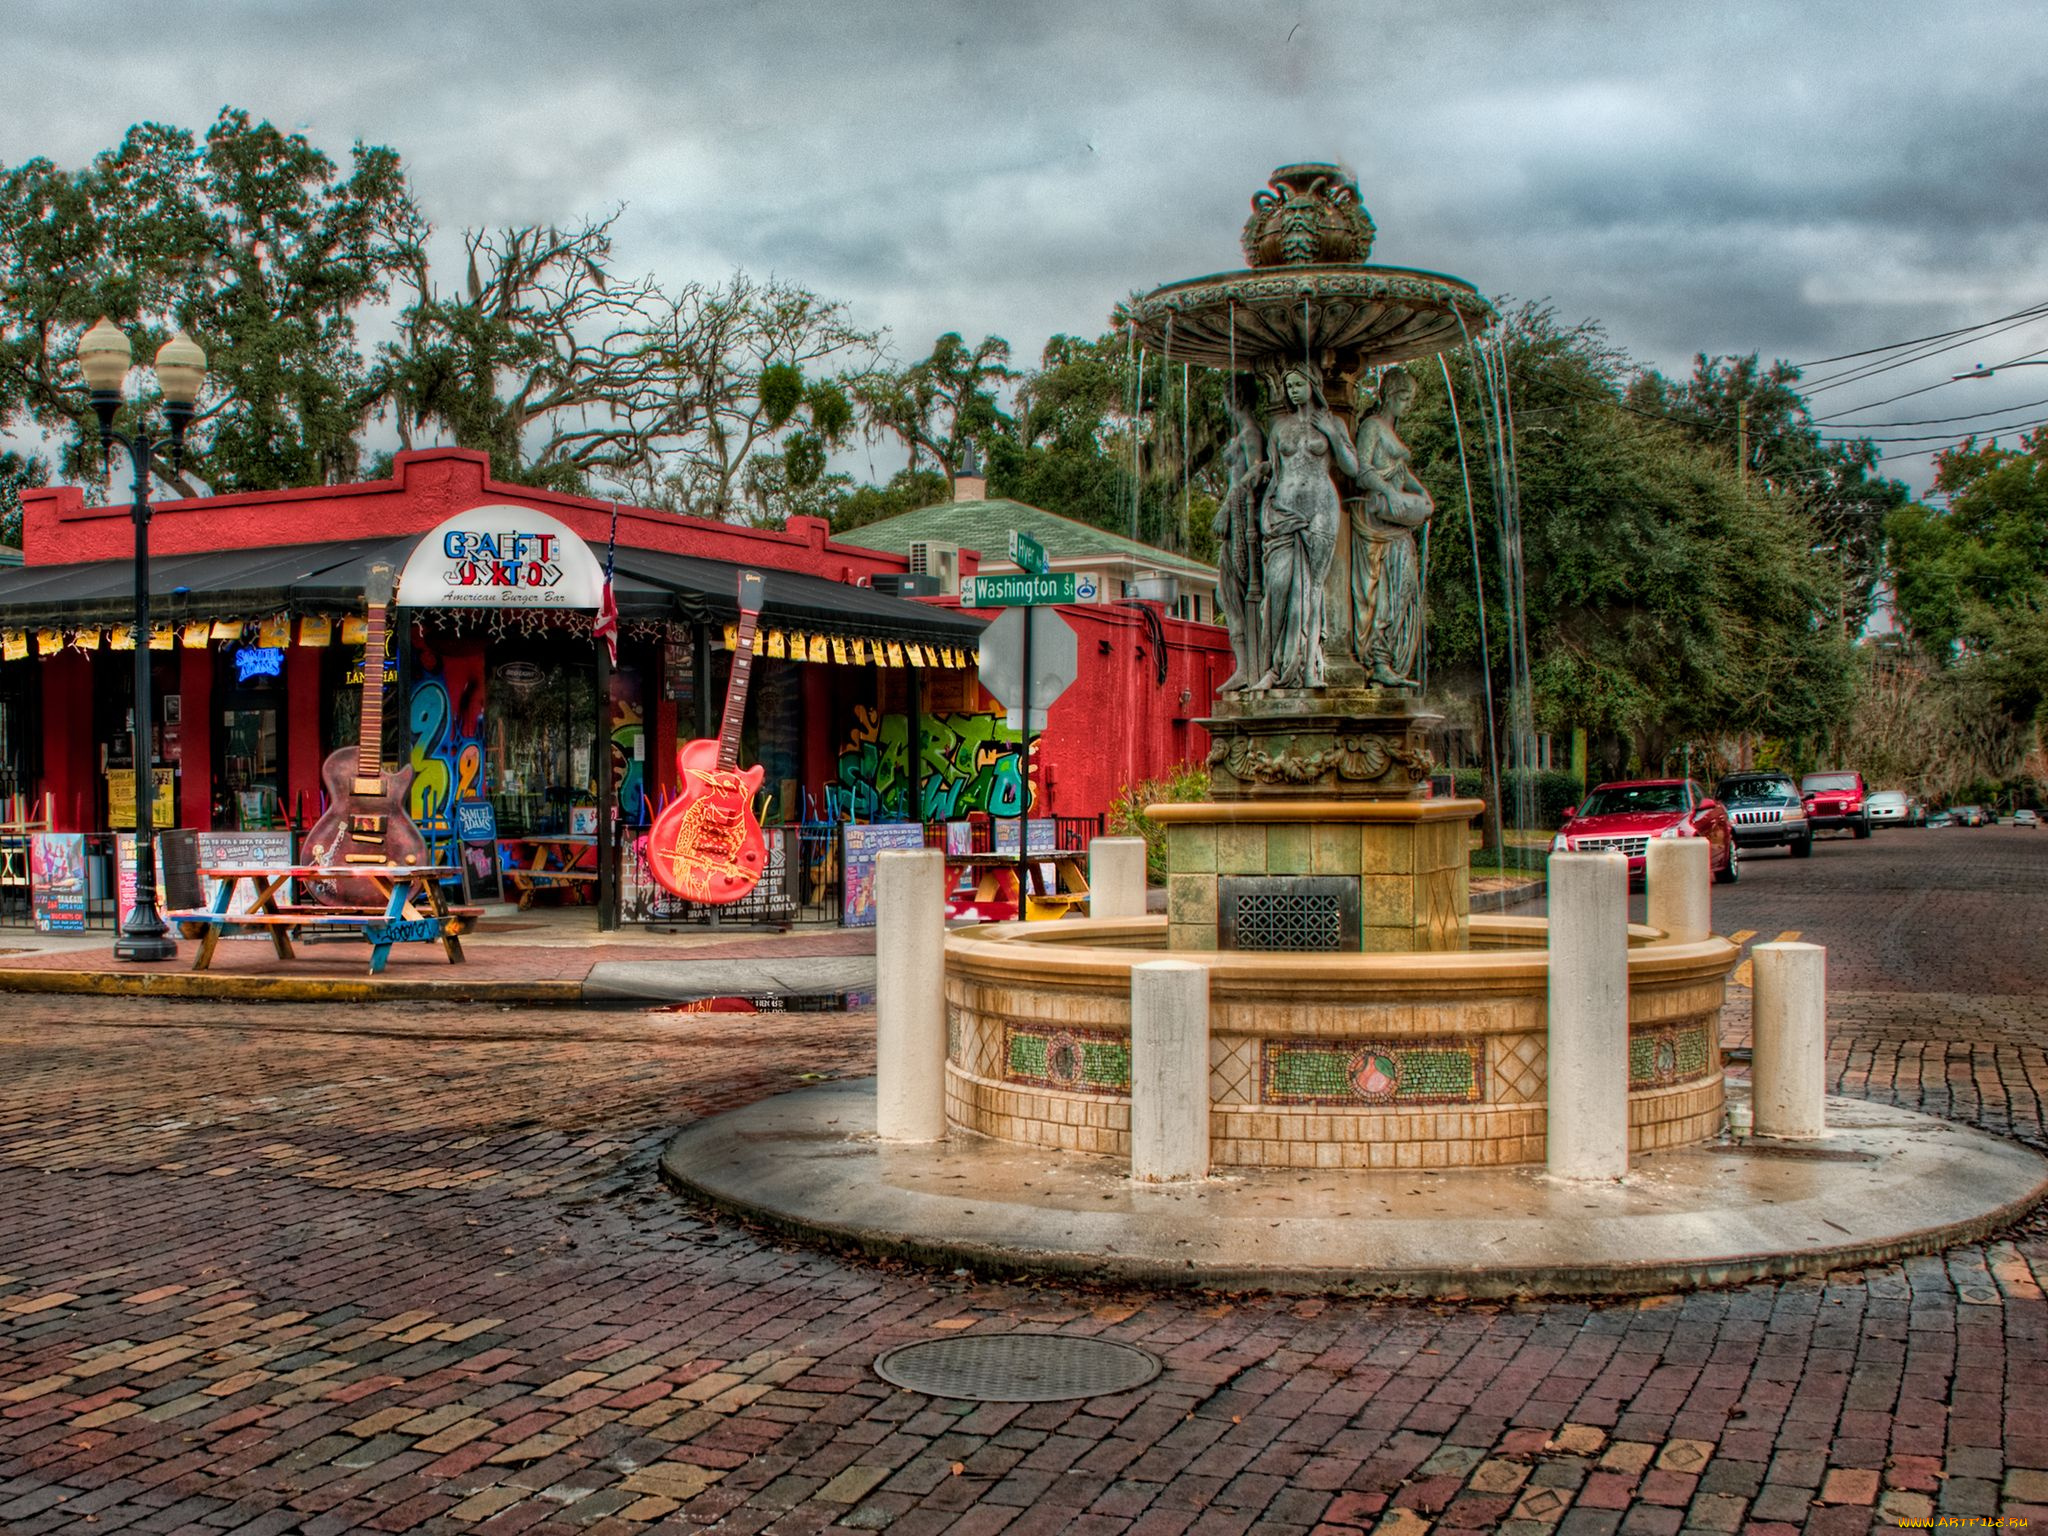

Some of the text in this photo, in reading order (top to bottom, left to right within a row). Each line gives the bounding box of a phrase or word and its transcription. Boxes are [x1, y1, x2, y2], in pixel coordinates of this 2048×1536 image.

[444, 530, 561, 563] GRAFFITI
[1018, 538, 1035, 565] Hyer
[443, 560, 563, 589] JUNKTION
[442, 590, 566, 605] American Burger Bar
[977, 577, 1074, 603] Washington St
[235, 648, 285, 667] SAMUEL
[238, 660, 281, 682] ADAMS
[459, 806, 493, 823] SAMUEL
[463, 818, 491, 832] ADAMS
